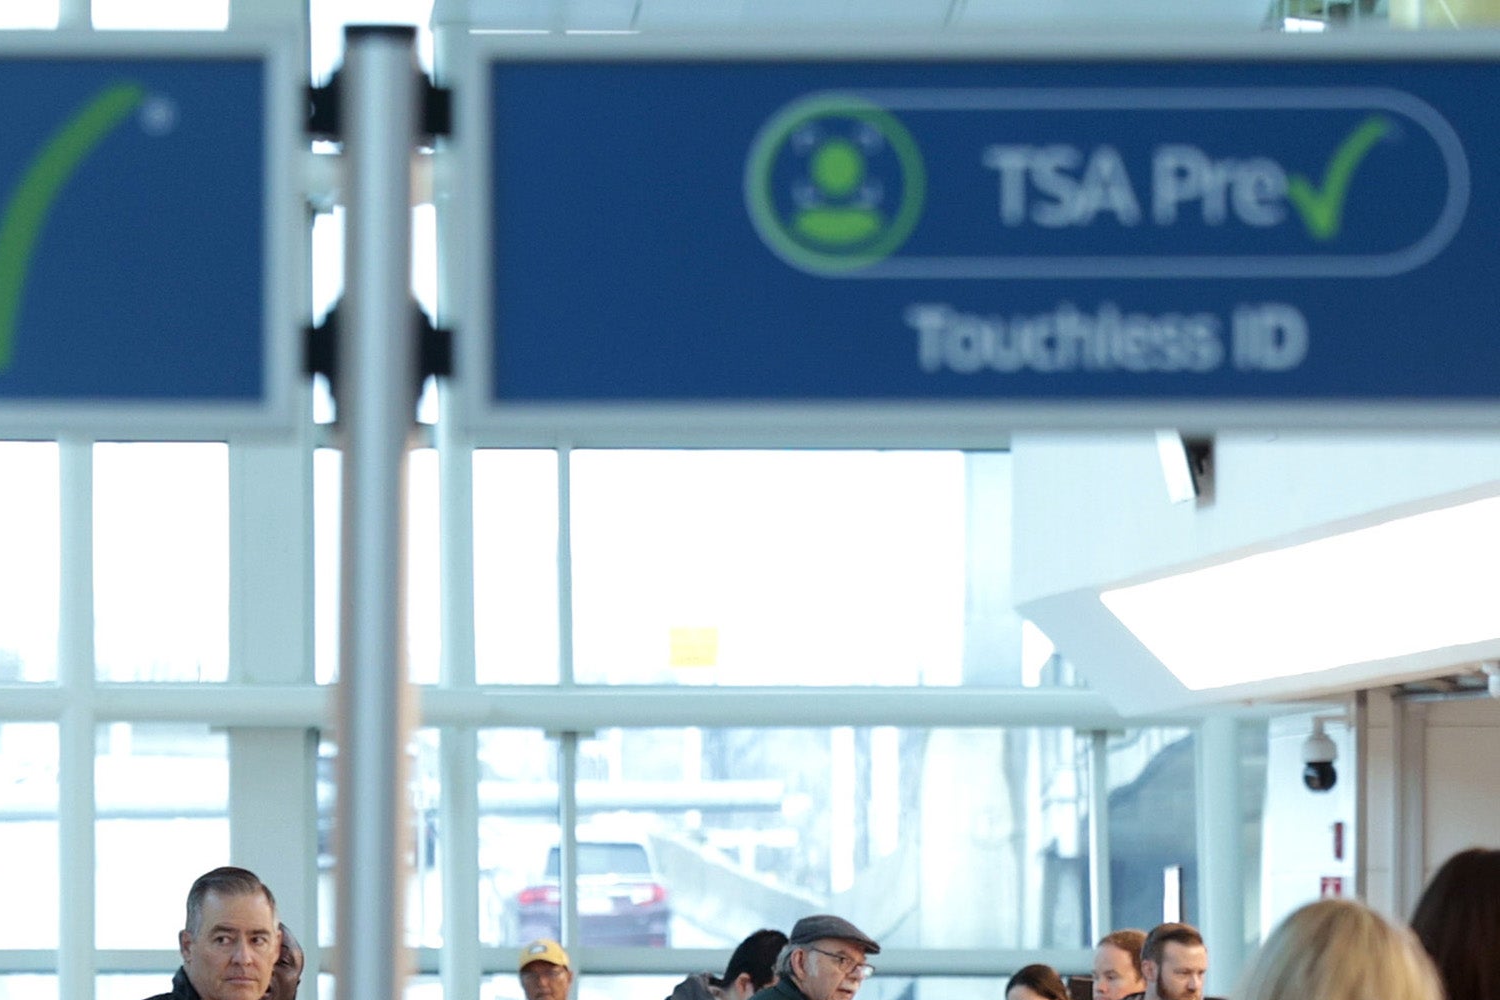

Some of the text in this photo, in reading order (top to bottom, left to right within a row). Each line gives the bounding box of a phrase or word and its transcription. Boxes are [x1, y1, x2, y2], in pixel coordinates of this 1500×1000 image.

[984, 144, 1289, 228] TSA Pre
[906, 302, 1310, 373] Touchless ID
